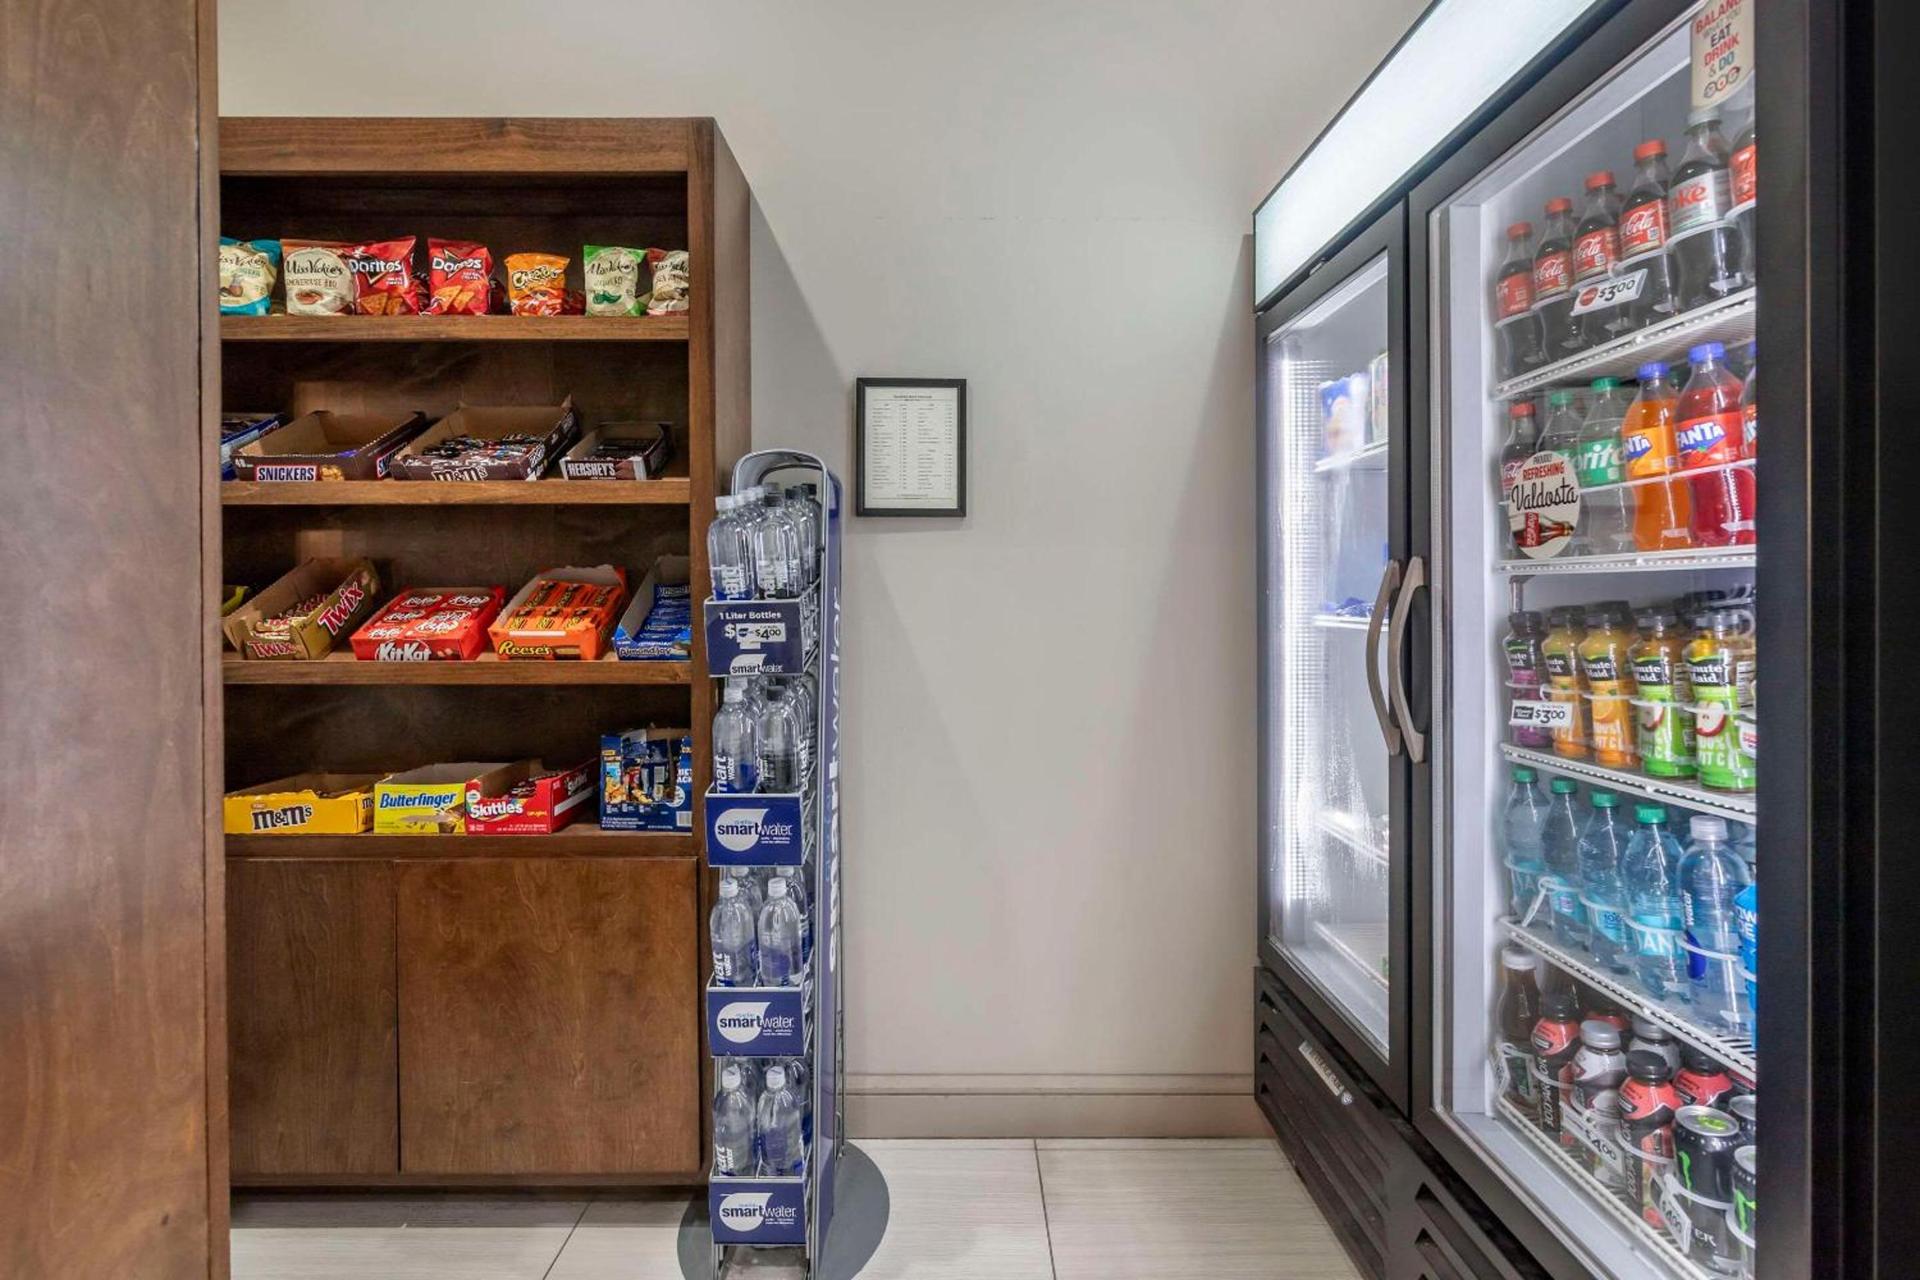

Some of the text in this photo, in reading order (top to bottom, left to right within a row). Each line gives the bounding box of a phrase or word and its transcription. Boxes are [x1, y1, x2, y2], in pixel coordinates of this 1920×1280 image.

[1711, 22, 1732, 47] EAT
[1704, 33, 1739, 66] DRINK
[349, 258, 402, 273] Doritos
[1625, 435, 1651, 453] NTA
[258, 466, 314, 481] SNICKERS
[567, 462, 616, 477] HERSHEY'S
[1523, 461, 1565, 480] REFRESHING
[1511, 477, 1579, 511] Valdosta
[317, 581, 364, 636] Twix
[726, 612, 747, 620] Liter
[749, 611, 782, 620] Bottles
[249, 640, 296, 658] Twix
[1690, 664, 1723, 673] nute
[379, 792, 457, 809] Butterfinger
[470, 801, 524, 819] Skittles
